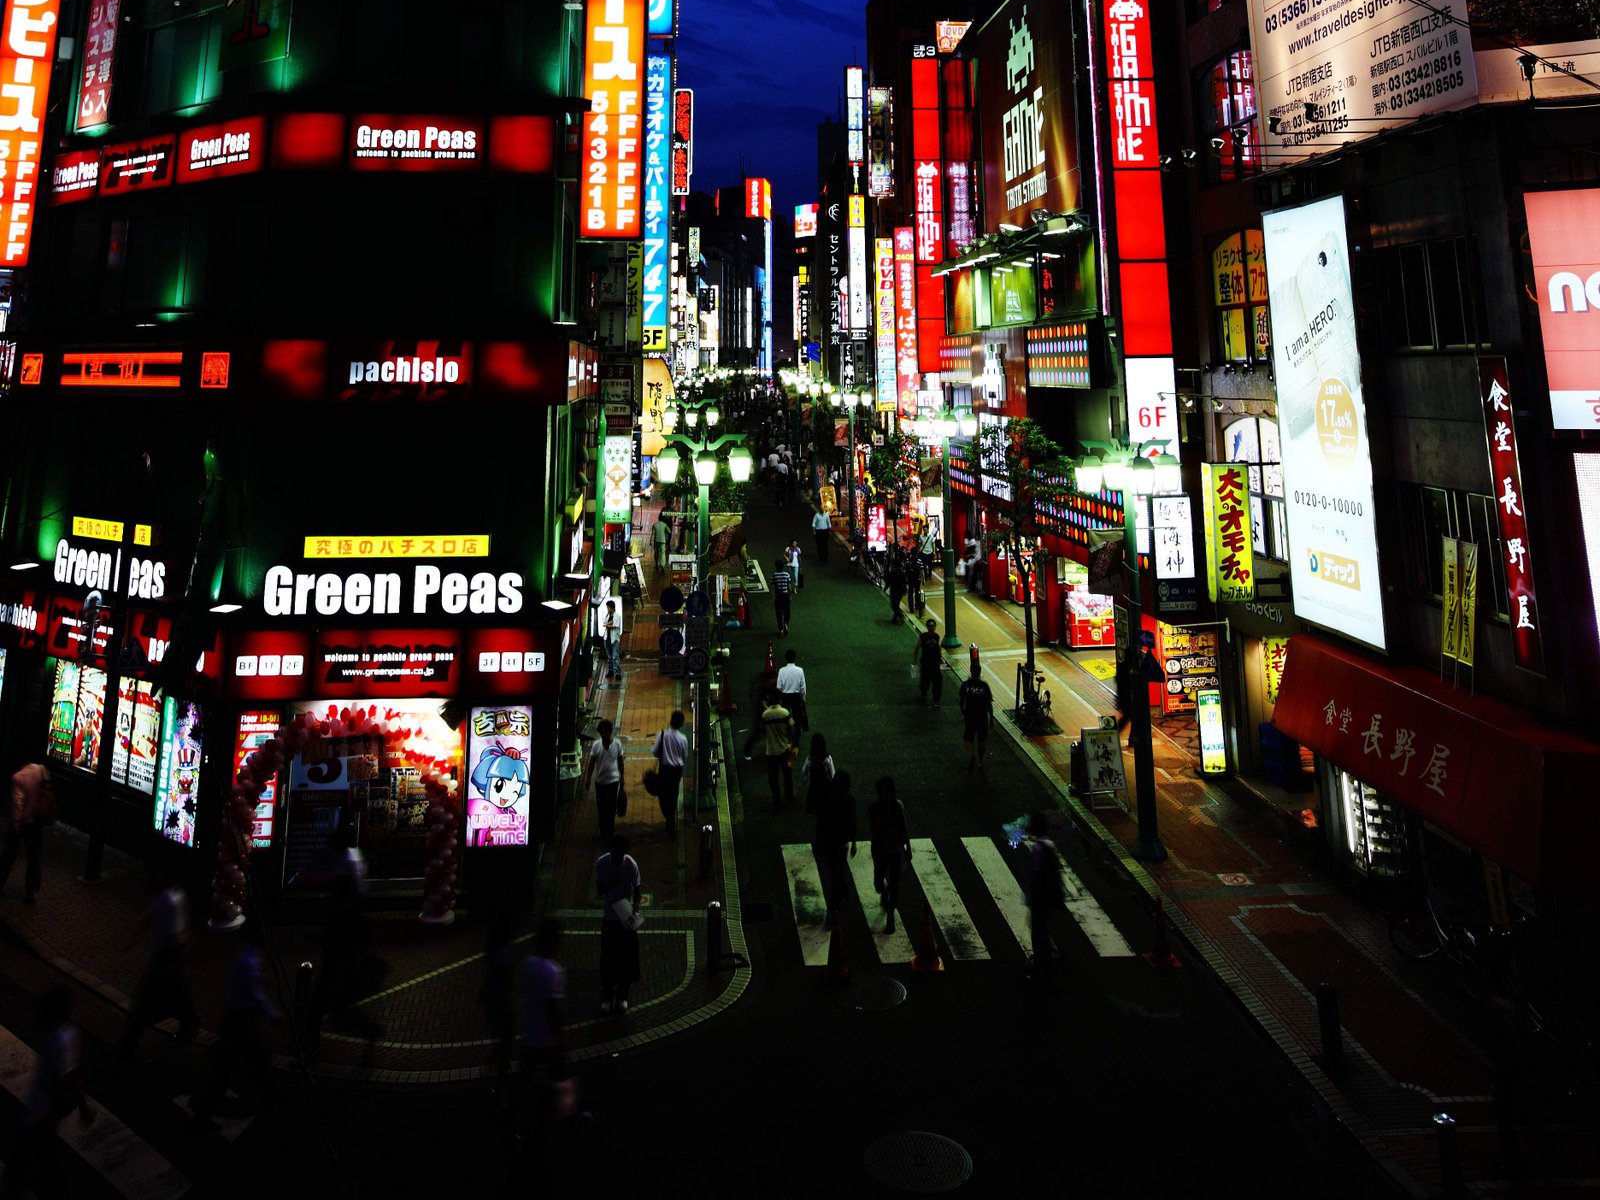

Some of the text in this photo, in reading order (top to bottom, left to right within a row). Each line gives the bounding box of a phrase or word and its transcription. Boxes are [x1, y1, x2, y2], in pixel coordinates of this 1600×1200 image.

[1370, 5, 1453, 58] JTB新宿西口支店
[926, 45, 936, 56] 3
[1111, 23, 1122, 79] TAITO
[1119, 23, 1151, 162] GAME
[1286, 61, 1333, 96] JTB新宿支店
[590, 91, 637, 113] 5F
[357, 125, 476, 149] Green Peas
[590, 114, 637, 136] 4F
[1003, 86, 1047, 182] GAME
[190, 138, 222, 161] Green
[223, 132, 250, 155] Peas
[590, 138, 637, 160] 3F
[645, 73, 665, 235] カラオケ&パーティ
[54, 164, 77, 185] Green
[78, 161, 98, 182] Peas
[589, 162, 636, 184] 2F
[589, 186, 635, 208] 1F
[1006, 186, 1022, 211] TAITO
[588, 210, 634, 230] BF
[923, 178, 940, 261] GAME
[643, 238, 664, 323] 747
[879, 257, 894, 290] DVD
[1219, 270, 1243, 304] 整体
[829, 234, 840, 345] セントラルホテル東京
[1138, 406, 1167, 428] 6F
[1294, 490, 1364, 518] 0120-0-10000
[1486, 378, 1536, 632] 食堂 長野屋
[1216, 468, 1250, 585] 大人のオモチャ
[315, 539, 478, 556] 究極のパチスロ店
[54, 538, 112, 591] Green
[1323, 557, 1356, 584] ディック
[264, 565, 523, 616] Green Peas
[342, 667, 435, 677] www.greenpeas.co.jp
[482, 658, 496, 667] 3F
[527, 657, 541, 667] 5F
[473, 708, 530, 738] 吉宗
[1322, 698, 1451, 798] 食堂 長野屋
[470, 814, 526, 829] LOVELY
[490, 830, 526, 846] TIME
